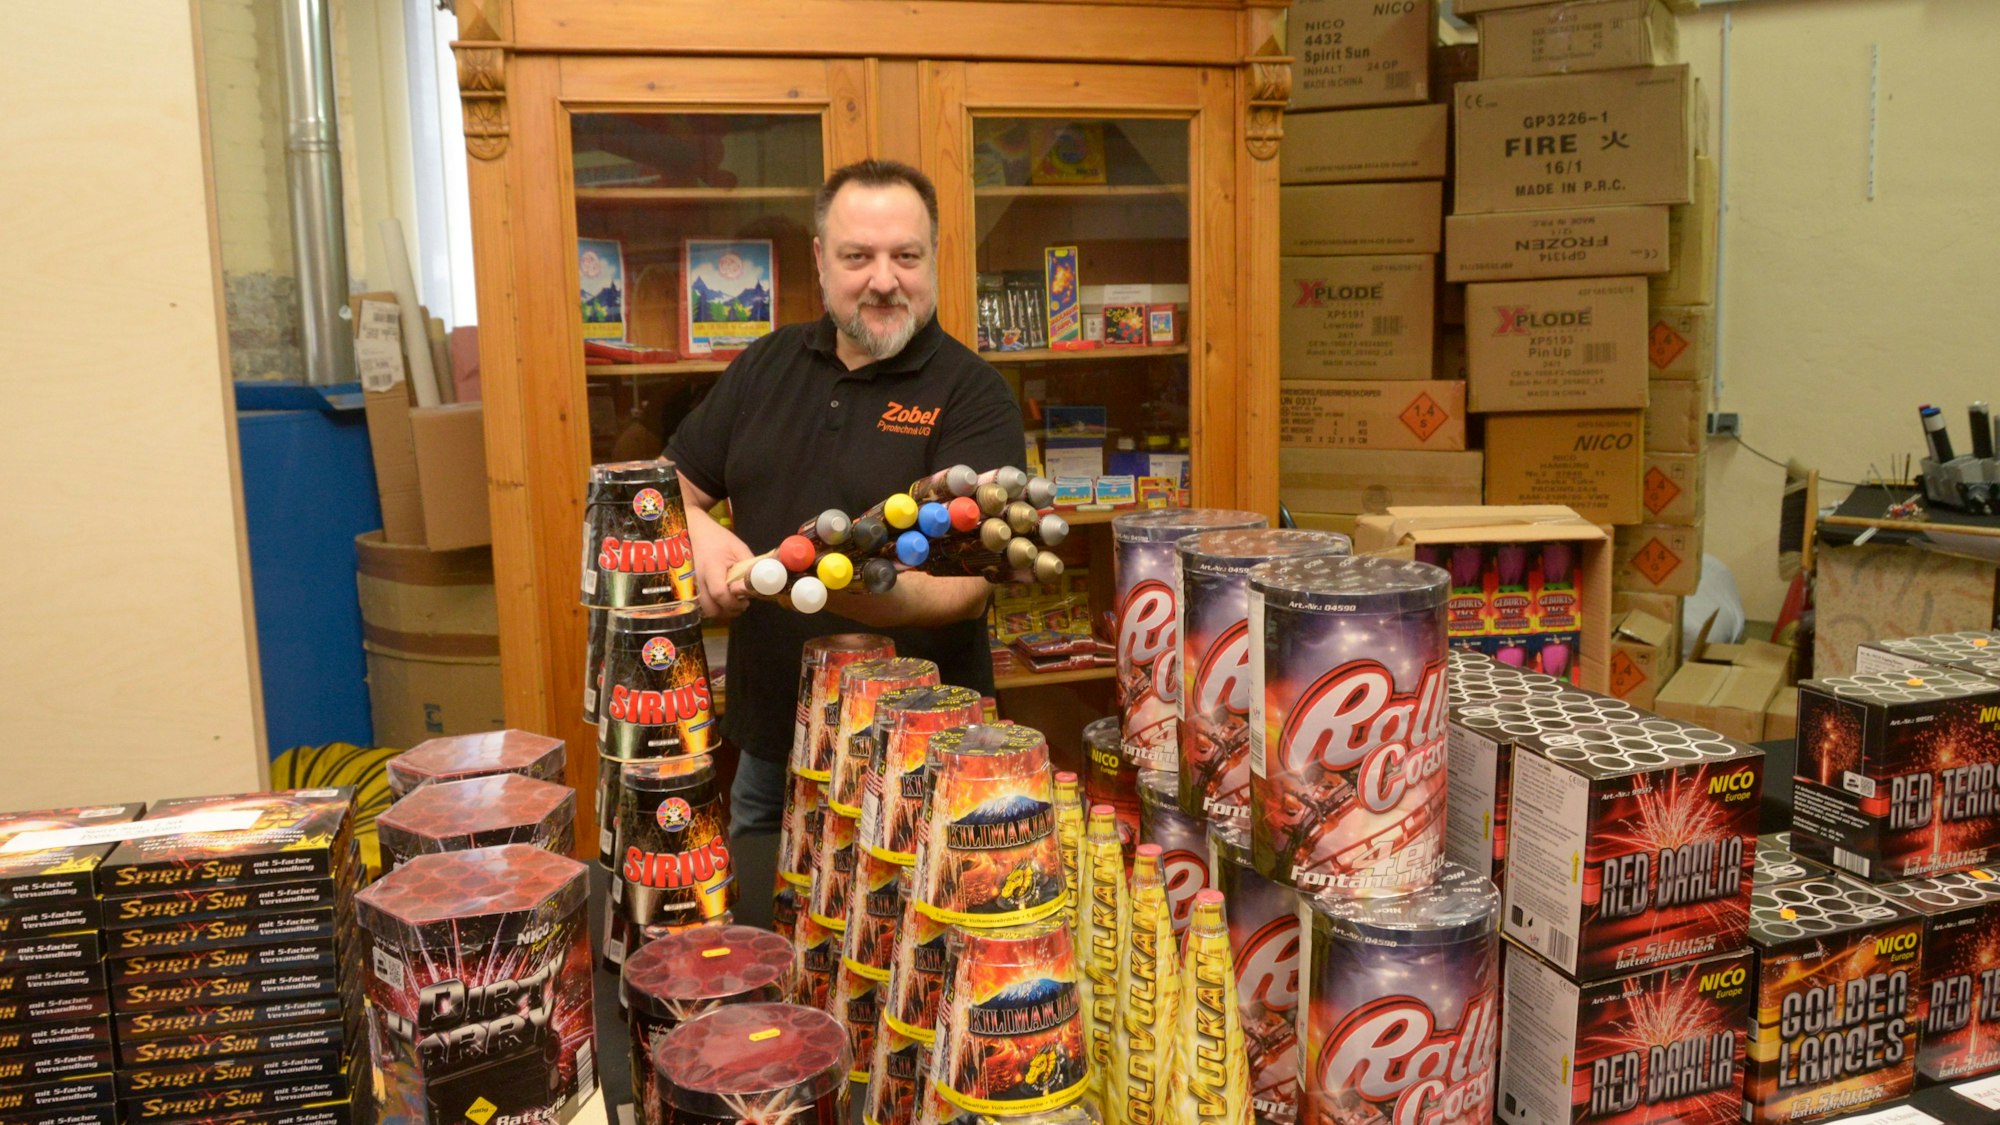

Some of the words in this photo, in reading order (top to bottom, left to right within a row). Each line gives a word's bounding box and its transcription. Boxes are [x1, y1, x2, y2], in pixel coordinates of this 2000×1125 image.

[1374, 2, 1415, 16] NICO
[1305, 20, 1345, 31] NICO
[1305, 33, 1342, 46] 4432
[1305, 50, 1341, 64] Spirit
[1345, 48, 1370, 58] Sun
[1367, 63, 1380, 71] 24
[1303, 79, 1331, 89] MADE
[1337, 77, 1363, 87] CHINA
[1523, 112, 1608, 129] GP3226-1
[1505, 134, 1578, 157] FIRE
[1602, 131, 1629, 150] 火
[1545, 160, 1582, 175] 16/1
[1516, 183, 1553, 196] MADE
[1562, 181, 1576, 193] IN
[1584, 179, 1626, 192] P.R.C.
[1557, 218, 1567, 226] IN
[1572, 217, 1595, 225] MADE
[1515, 236, 1608, 252] FROZEN
[1539, 251, 1586, 262] GP1314
[1295, 278, 1384, 308] XPLODE
[1327, 310, 1365, 319] XP5191
[1493, 305, 1592, 336] XPLODE
[1530, 336, 1574, 346] XP5193
[1529, 349, 1546, 357] Pin
[1553, 348, 1572, 359] Up
[881, 401, 941, 426] Zobel
[1414, 405, 1434, 417] 1.4
[919, 426, 931, 436] UG
[1420, 419, 1427, 428] S
[1574, 433, 1633, 451] NICO
[599, 528, 693, 574] SIRIUS
[1645, 550, 1665, 562] 1.4
[1200, 563, 1227, 573] Art.-Nr.:
[1289, 601, 1322, 611] Art.-Nr.:
[1324, 604, 1357, 612] 04590
[610, 677, 711, 726] SIRIUS
[1284, 662, 1449, 773] Roll
[1092, 747, 1119, 768] NICO
[1358, 738, 1447, 812] Coas
[1708, 771, 1754, 795] NICO
[1601, 791, 1630, 801] Art.-Nr.:
[1725, 791, 1751, 802] Europe
[1889, 771, 1933, 830] RED
[1941, 762, 2000, 823] TEAR
[624, 834, 730, 889] SIRIUS
[1928, 848, 1987, 866] Schuss
[115, 866, 195, 886] SPIRIT
[201, 861, 242, 879] SUN
[254, 864, 314, 875] Verwandlung
[1600, 852, 1649, 918] RED
[1655, 835, 1743, 911] DAHLIA
[12, 884, 28, 892] mit
[13, 887, 77, 899] Verwandlung
[120, 898, 199, 919] SPIRIT
[207, 892, 247, 910] SUN
[517, 922, 549, 945] NICO
[1085, 855, 1118, 996] VULKAN
[121, 927, 200, 948] SPIRIT
[207, 922, 247, 941] SUN
[1365, 937, 1397, 948] 04590
[1874, 931, 1917, 955] NICO
[1615, 942, 1714, 970] Batteriefeuerwerk
[1617, 946, 1638, 963] 13
[1645, 933, 1717, 957] Schuss
[1891, 951, 1915, 962] Europe
[261, 977, 276, 985] mit
[1122, 900, 1157, 1051] VULKAN
[1699, 967, 1746, 993] NICO
[127, 985, 204, 1004] SPIRIT
[211, 979, 249, 997] SUN
[262, 980, 321, 992] Verwandlung
[1716, 987, 1742, 999] Europe
[1591, 994, 1621, 1005] Art.-Nr.:
[1781, 970, 1908, 1039] GOLDEN
[1927, 974, 1972, 1033] RED
[1188, 950, 1227, 1118] VULKAN
[136, 1044, 213, 1062] SPIRIT
[219, 1035, 258, 1054] SUN
[1779, 1018, 1906, 1089] LANCES
[35, 1059, 51, 1067] mit
[37, 1062, 98, 1073] Verwandlung
[1591, 1050, 1640, 1116] RED
[1649, 1029, 1735, 1103] DAHLIA
[143, 1099, 219, 1117] SPIRIT
[225, 1091, 263, 1107] SUN
[274, 1090, 333, 1102] Verwandlung
[496, 1094, 566, 1125] Batterie
